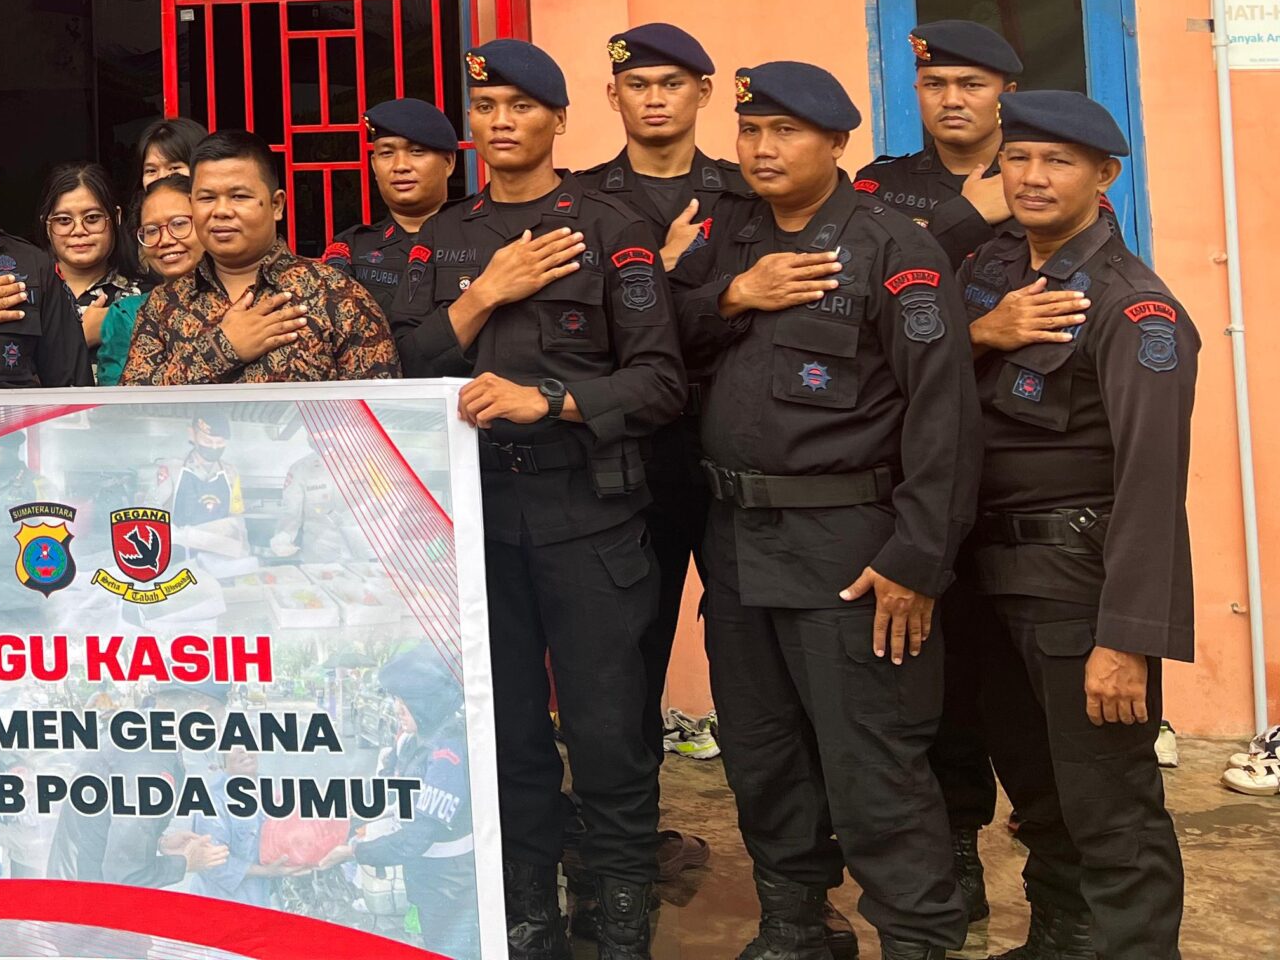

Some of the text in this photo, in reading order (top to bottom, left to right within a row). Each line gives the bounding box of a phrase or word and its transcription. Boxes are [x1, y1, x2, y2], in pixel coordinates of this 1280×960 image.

[1229, 33, 1263, 44] anyak
[883, 191, 938, 210] ROBBY
[435, 249, 477, 263] PINEM
[371, 270, 399, 285] PURBA
[12, 505, 73, 519] SUMATERA UTARA
[114, 510, 167, 522] GEGANA
[86, 635, 273, 683] KASIH
[110, 710, 343, 753] GEGANA
[35, 775, 217, 817] POLDA
[226, 777, 421, 819] SUMUT
